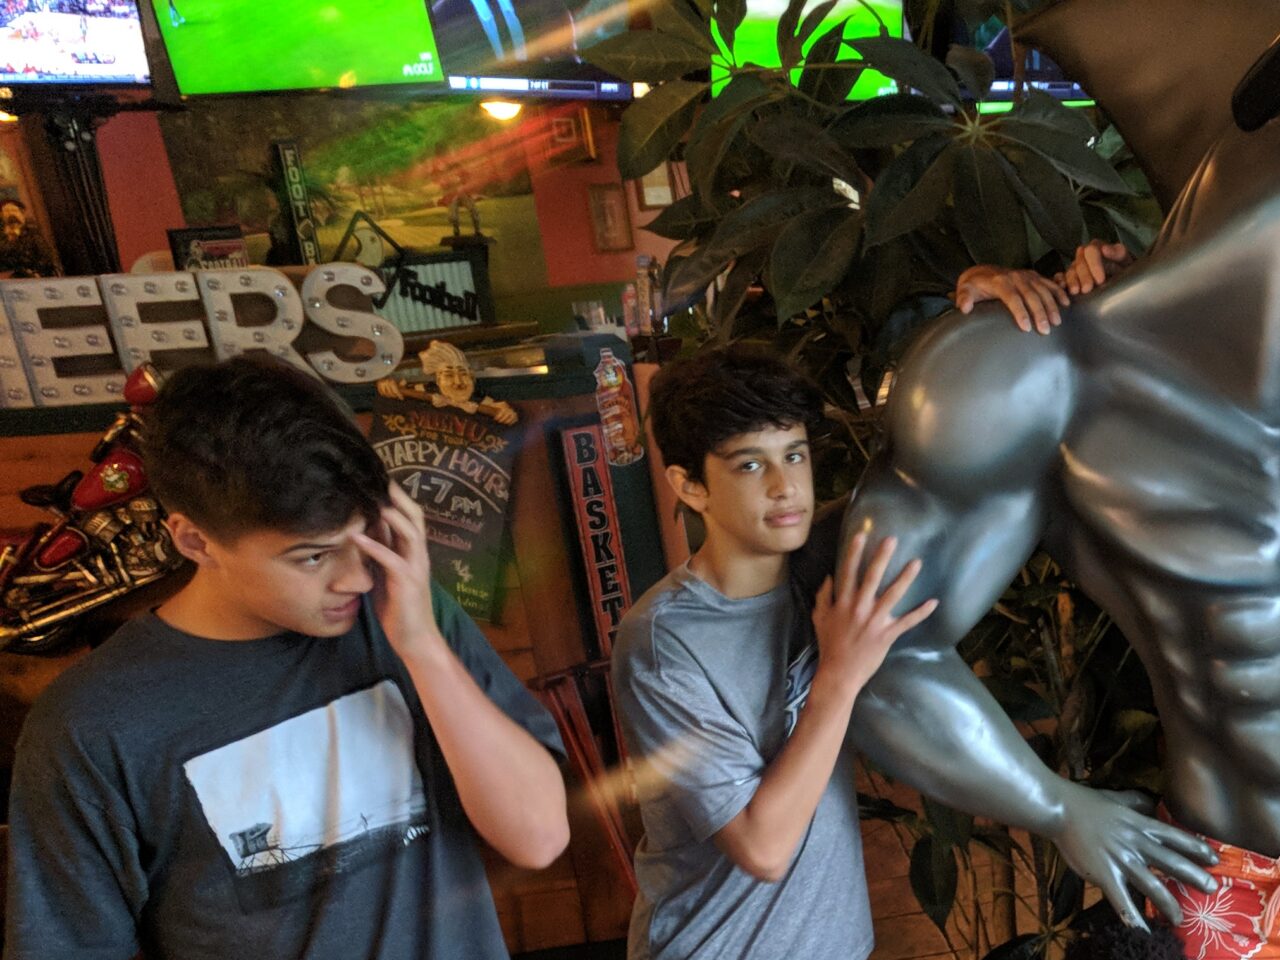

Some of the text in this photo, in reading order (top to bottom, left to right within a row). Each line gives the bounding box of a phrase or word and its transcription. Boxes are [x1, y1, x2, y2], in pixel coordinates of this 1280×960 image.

[0, 262, 404, 406] EERS
[376, 440, 509, 502] HAPPY HOUR
[451, 495, 484, 516] PM
